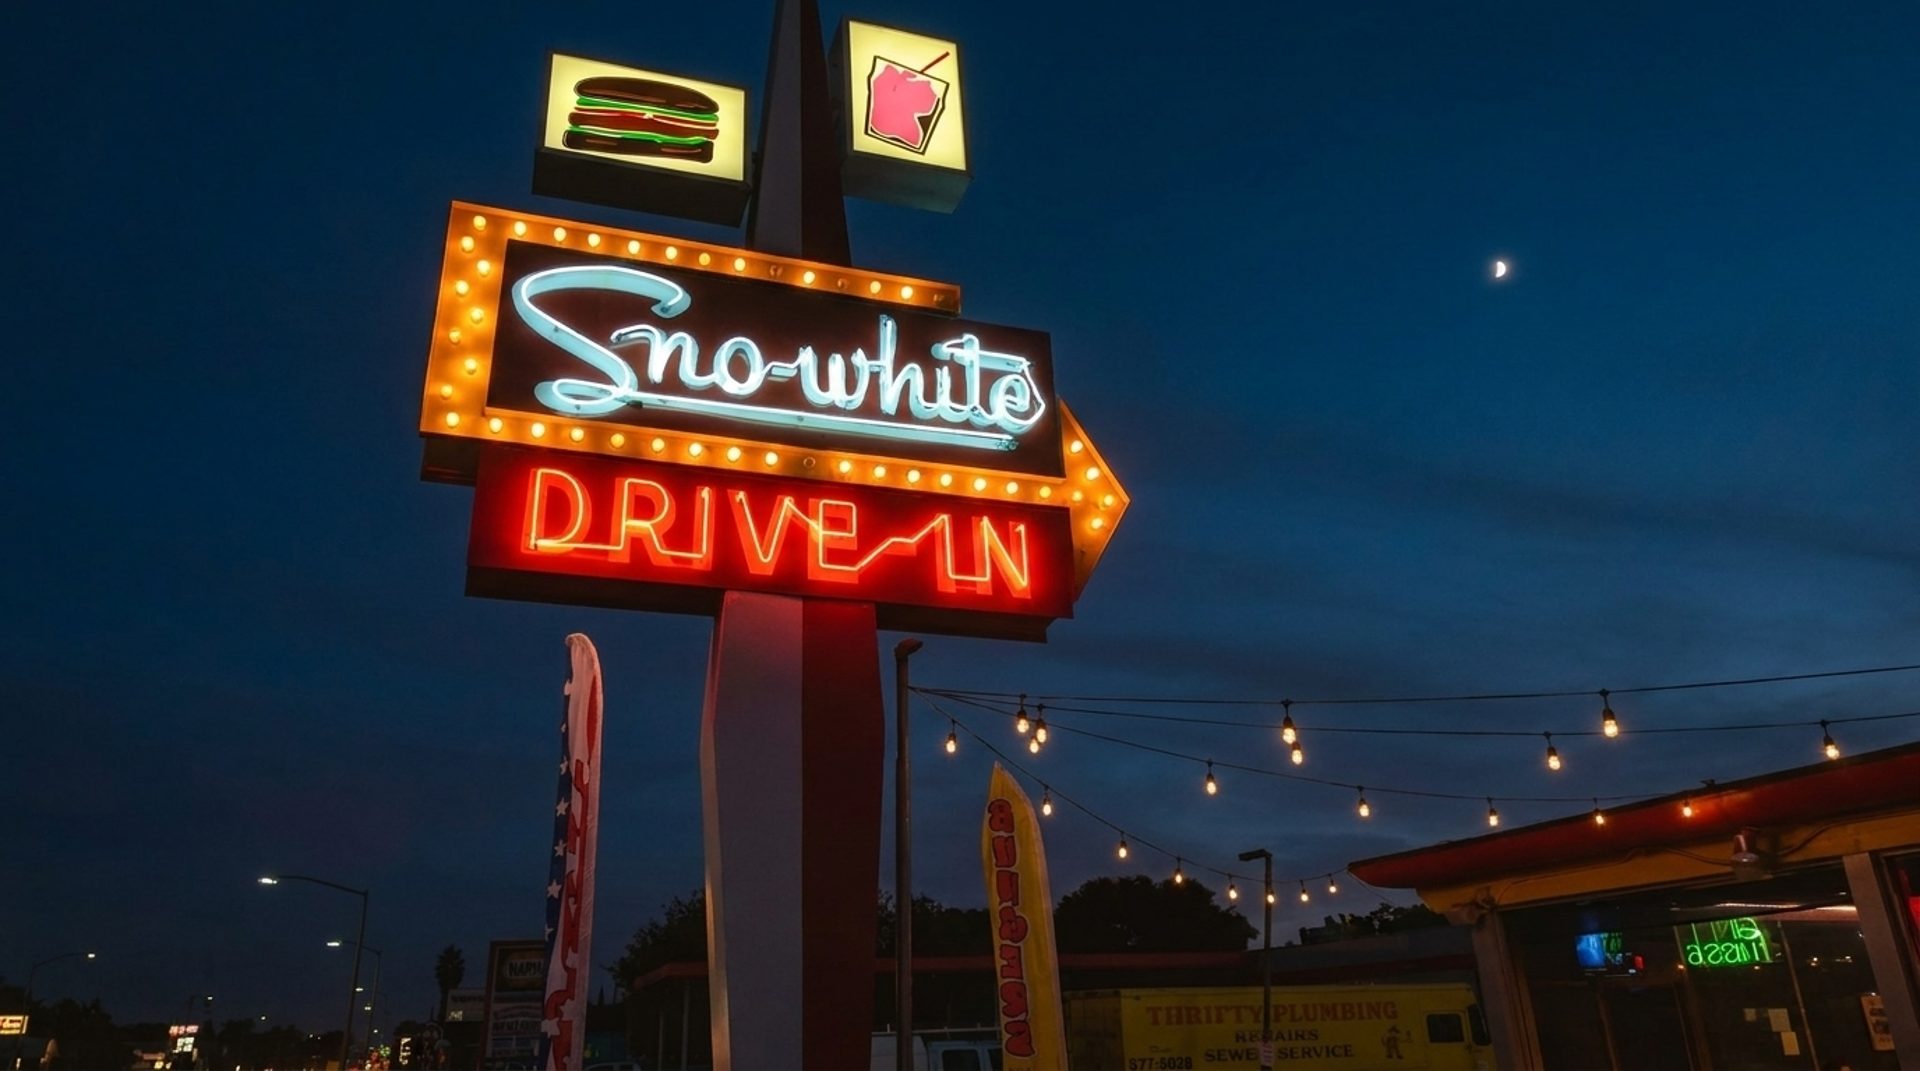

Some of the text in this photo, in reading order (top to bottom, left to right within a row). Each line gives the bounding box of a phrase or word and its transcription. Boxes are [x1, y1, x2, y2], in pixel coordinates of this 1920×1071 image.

[512, 265, 1045, 436] Sno-white
[1145, 1000, 1399, 1026] THRIFTY PLUMBING
[1203, 1046, 1263, 1063] SEWE
[1277, 1043, 1354, 1061] SERVICE
